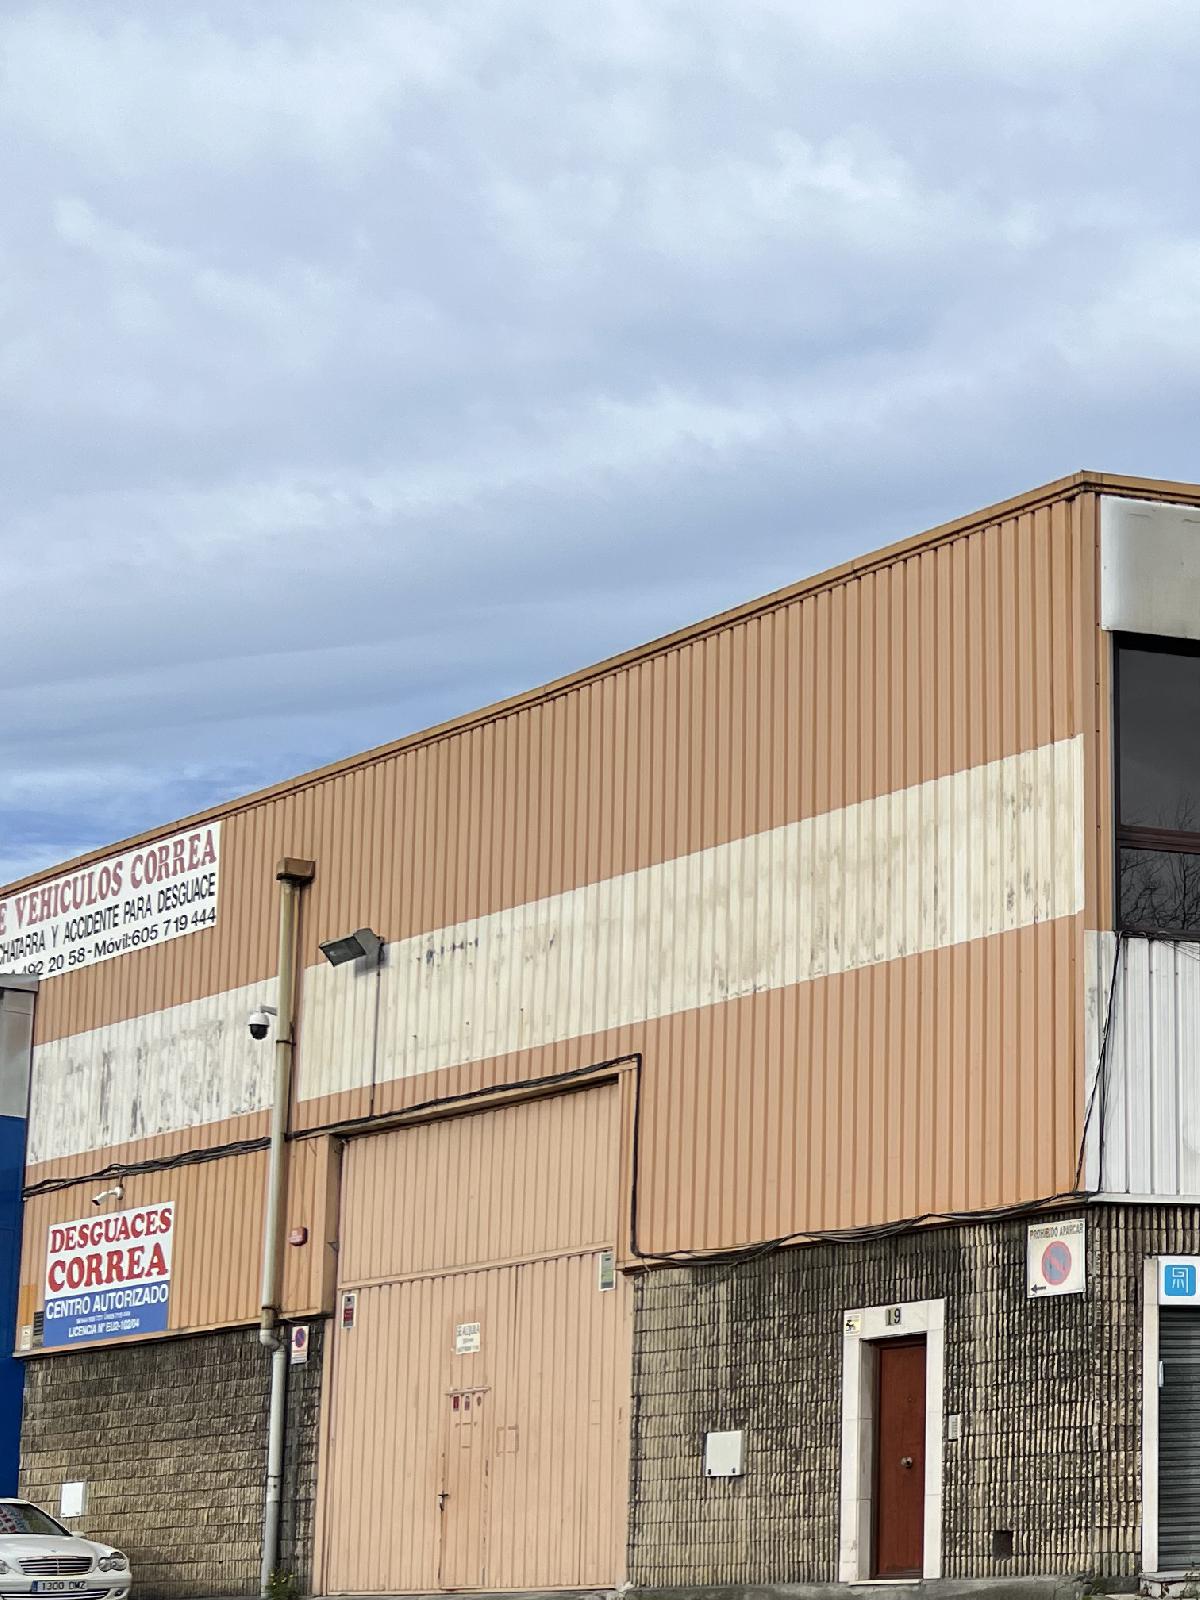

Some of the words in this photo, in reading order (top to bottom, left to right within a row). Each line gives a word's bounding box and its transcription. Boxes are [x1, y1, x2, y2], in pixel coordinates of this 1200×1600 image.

[14, 861, 124, 930] VEHICULOS
[130, 829, 217, 889] CORREA
[51, 924, 59, 948] Y
[62, 903, 120, 945] ACCIDENTE
[123, 894, 153, 925] PARA
[157, 872, 216, 914] DESGUACE
[47, 953, 65, 973] 20
[163, 914, 189, 936] 719
[191, 906, 217, 927] 444
[49, 1207, 173, 1254] DESGUACES
[47, 1241, 169, 1293] CORREA
[46, 1295, 91, 1320] CENTRO
[92, 1283, 169, 1313] AUTORIZADO
[887, 1307, 901, 1326] 19
